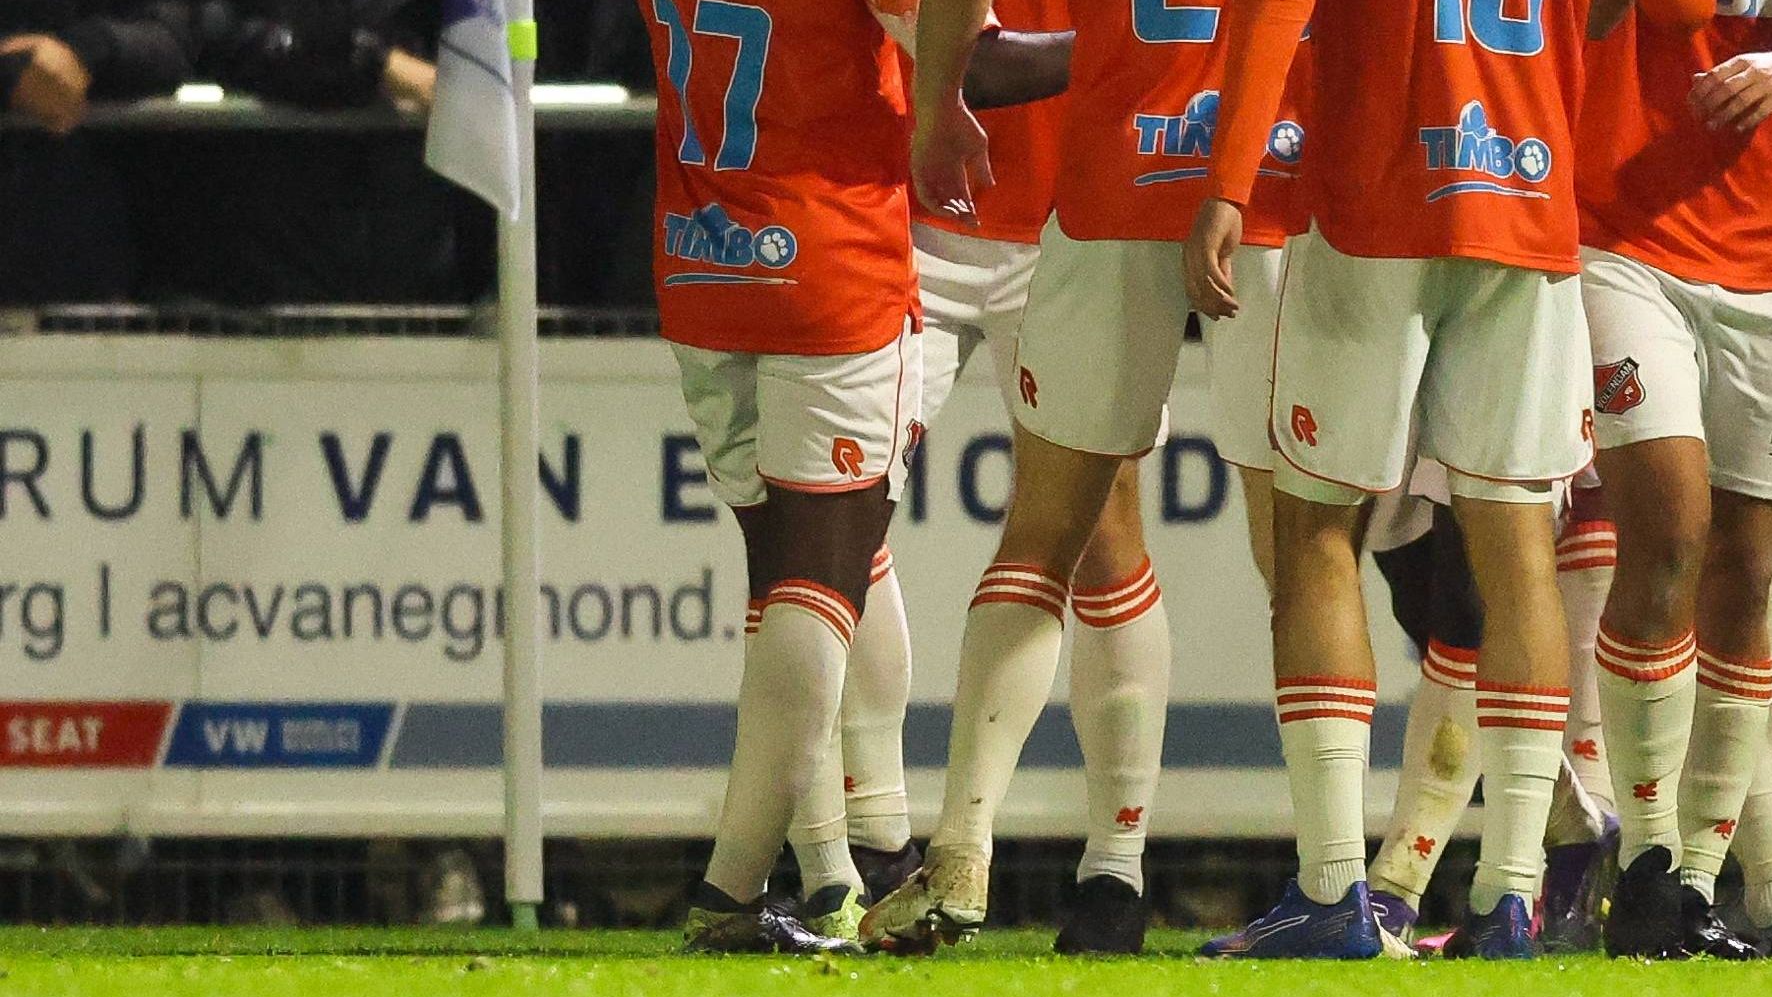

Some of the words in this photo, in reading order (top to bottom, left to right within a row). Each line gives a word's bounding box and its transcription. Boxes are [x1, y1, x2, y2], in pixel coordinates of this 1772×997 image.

[1419, 119, 1552, 183] TIMBO
[664, 207, 798, 270] TIMBO
[318, 431, 581, 523] VAN
[7, 716, 104, 755] SEAT
[203, 718, 268, 755] VW
